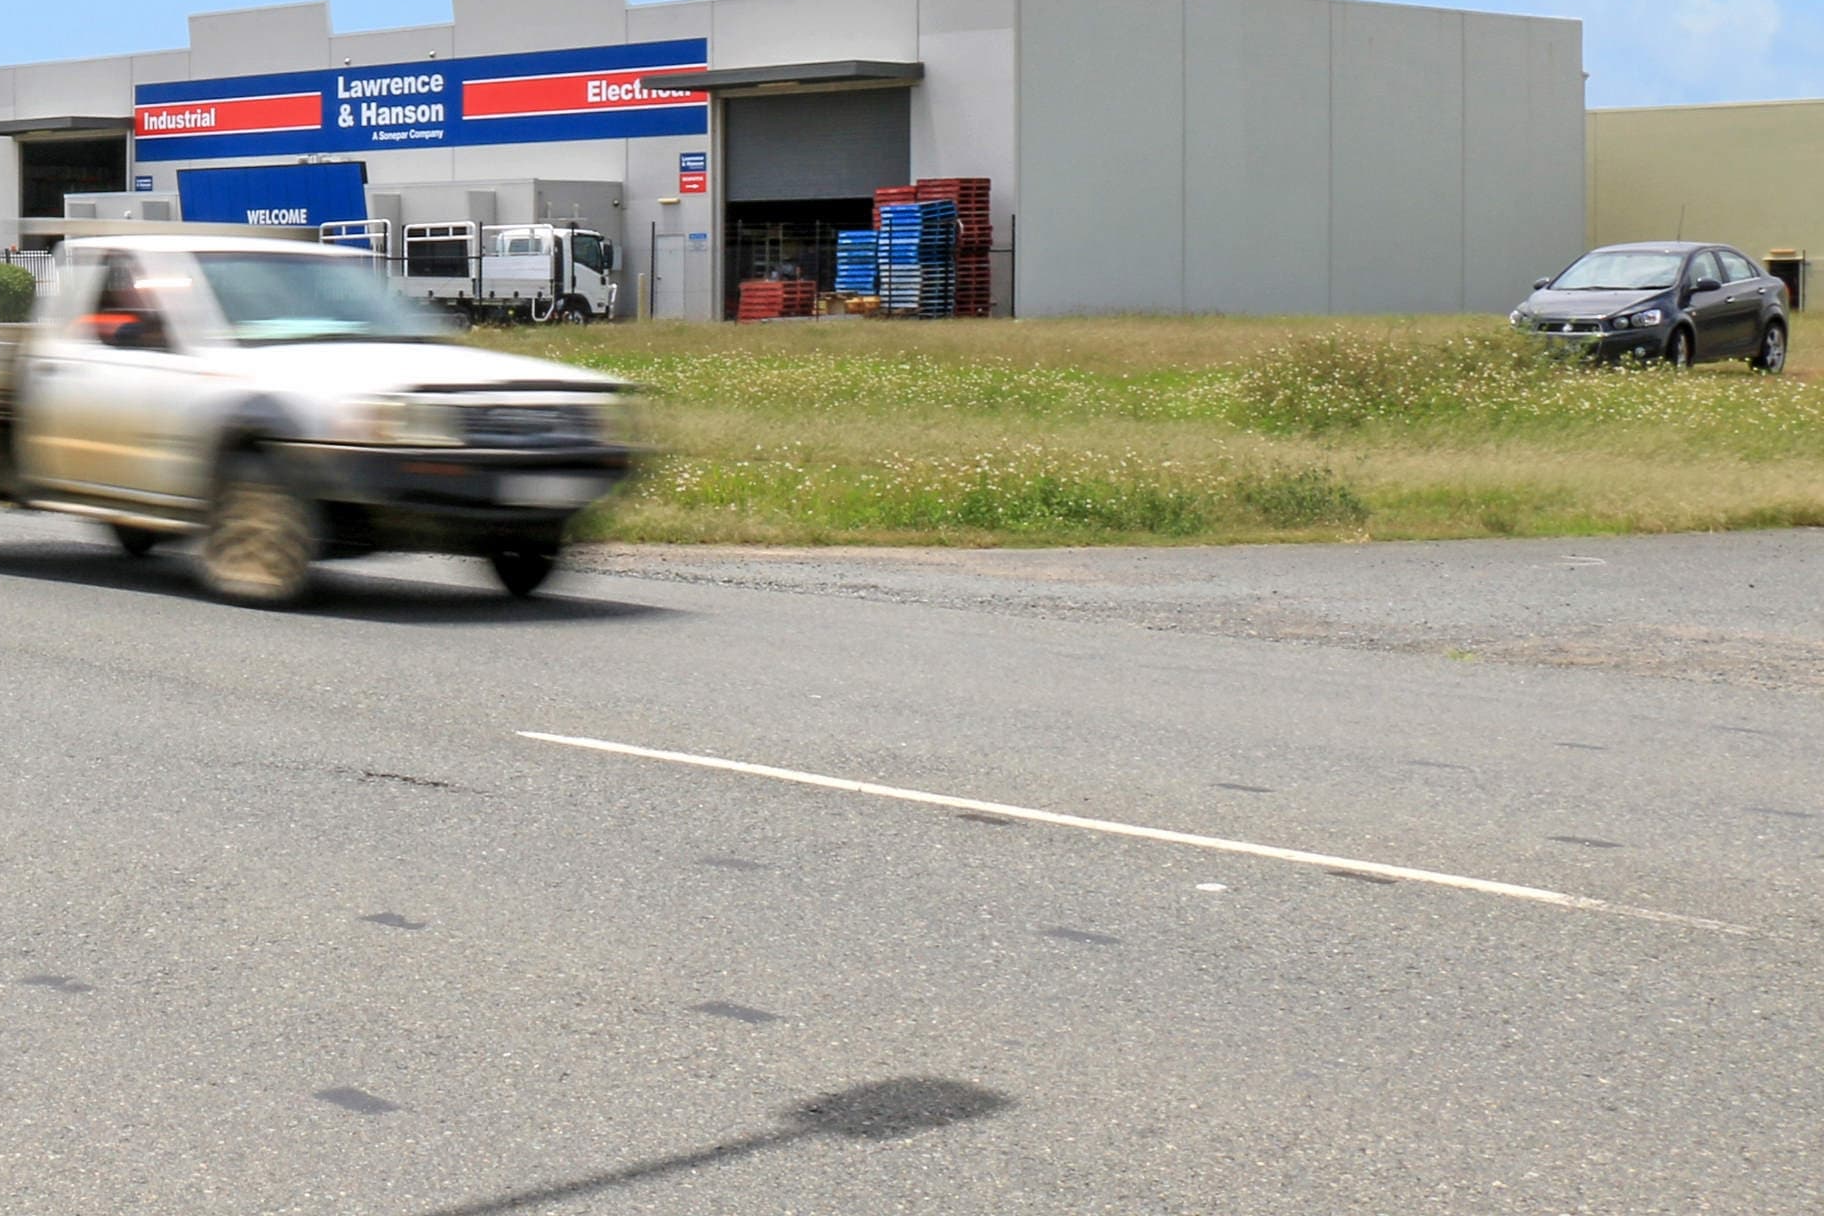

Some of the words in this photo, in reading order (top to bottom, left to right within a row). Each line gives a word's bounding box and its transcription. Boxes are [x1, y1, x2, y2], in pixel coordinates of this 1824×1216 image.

[338, 73, 444, 99] Lawrence
[143, 107, 216, 131] Industrial
[338, 103, 354, 128] &
[361, 102, 444, 126] Hanson
[372, 131, 378, 141] A
[379, 130, 408, 141] Sonepar
[409, 129, 444, 140] Company
[247, 208, 308, 225] WELCOME
